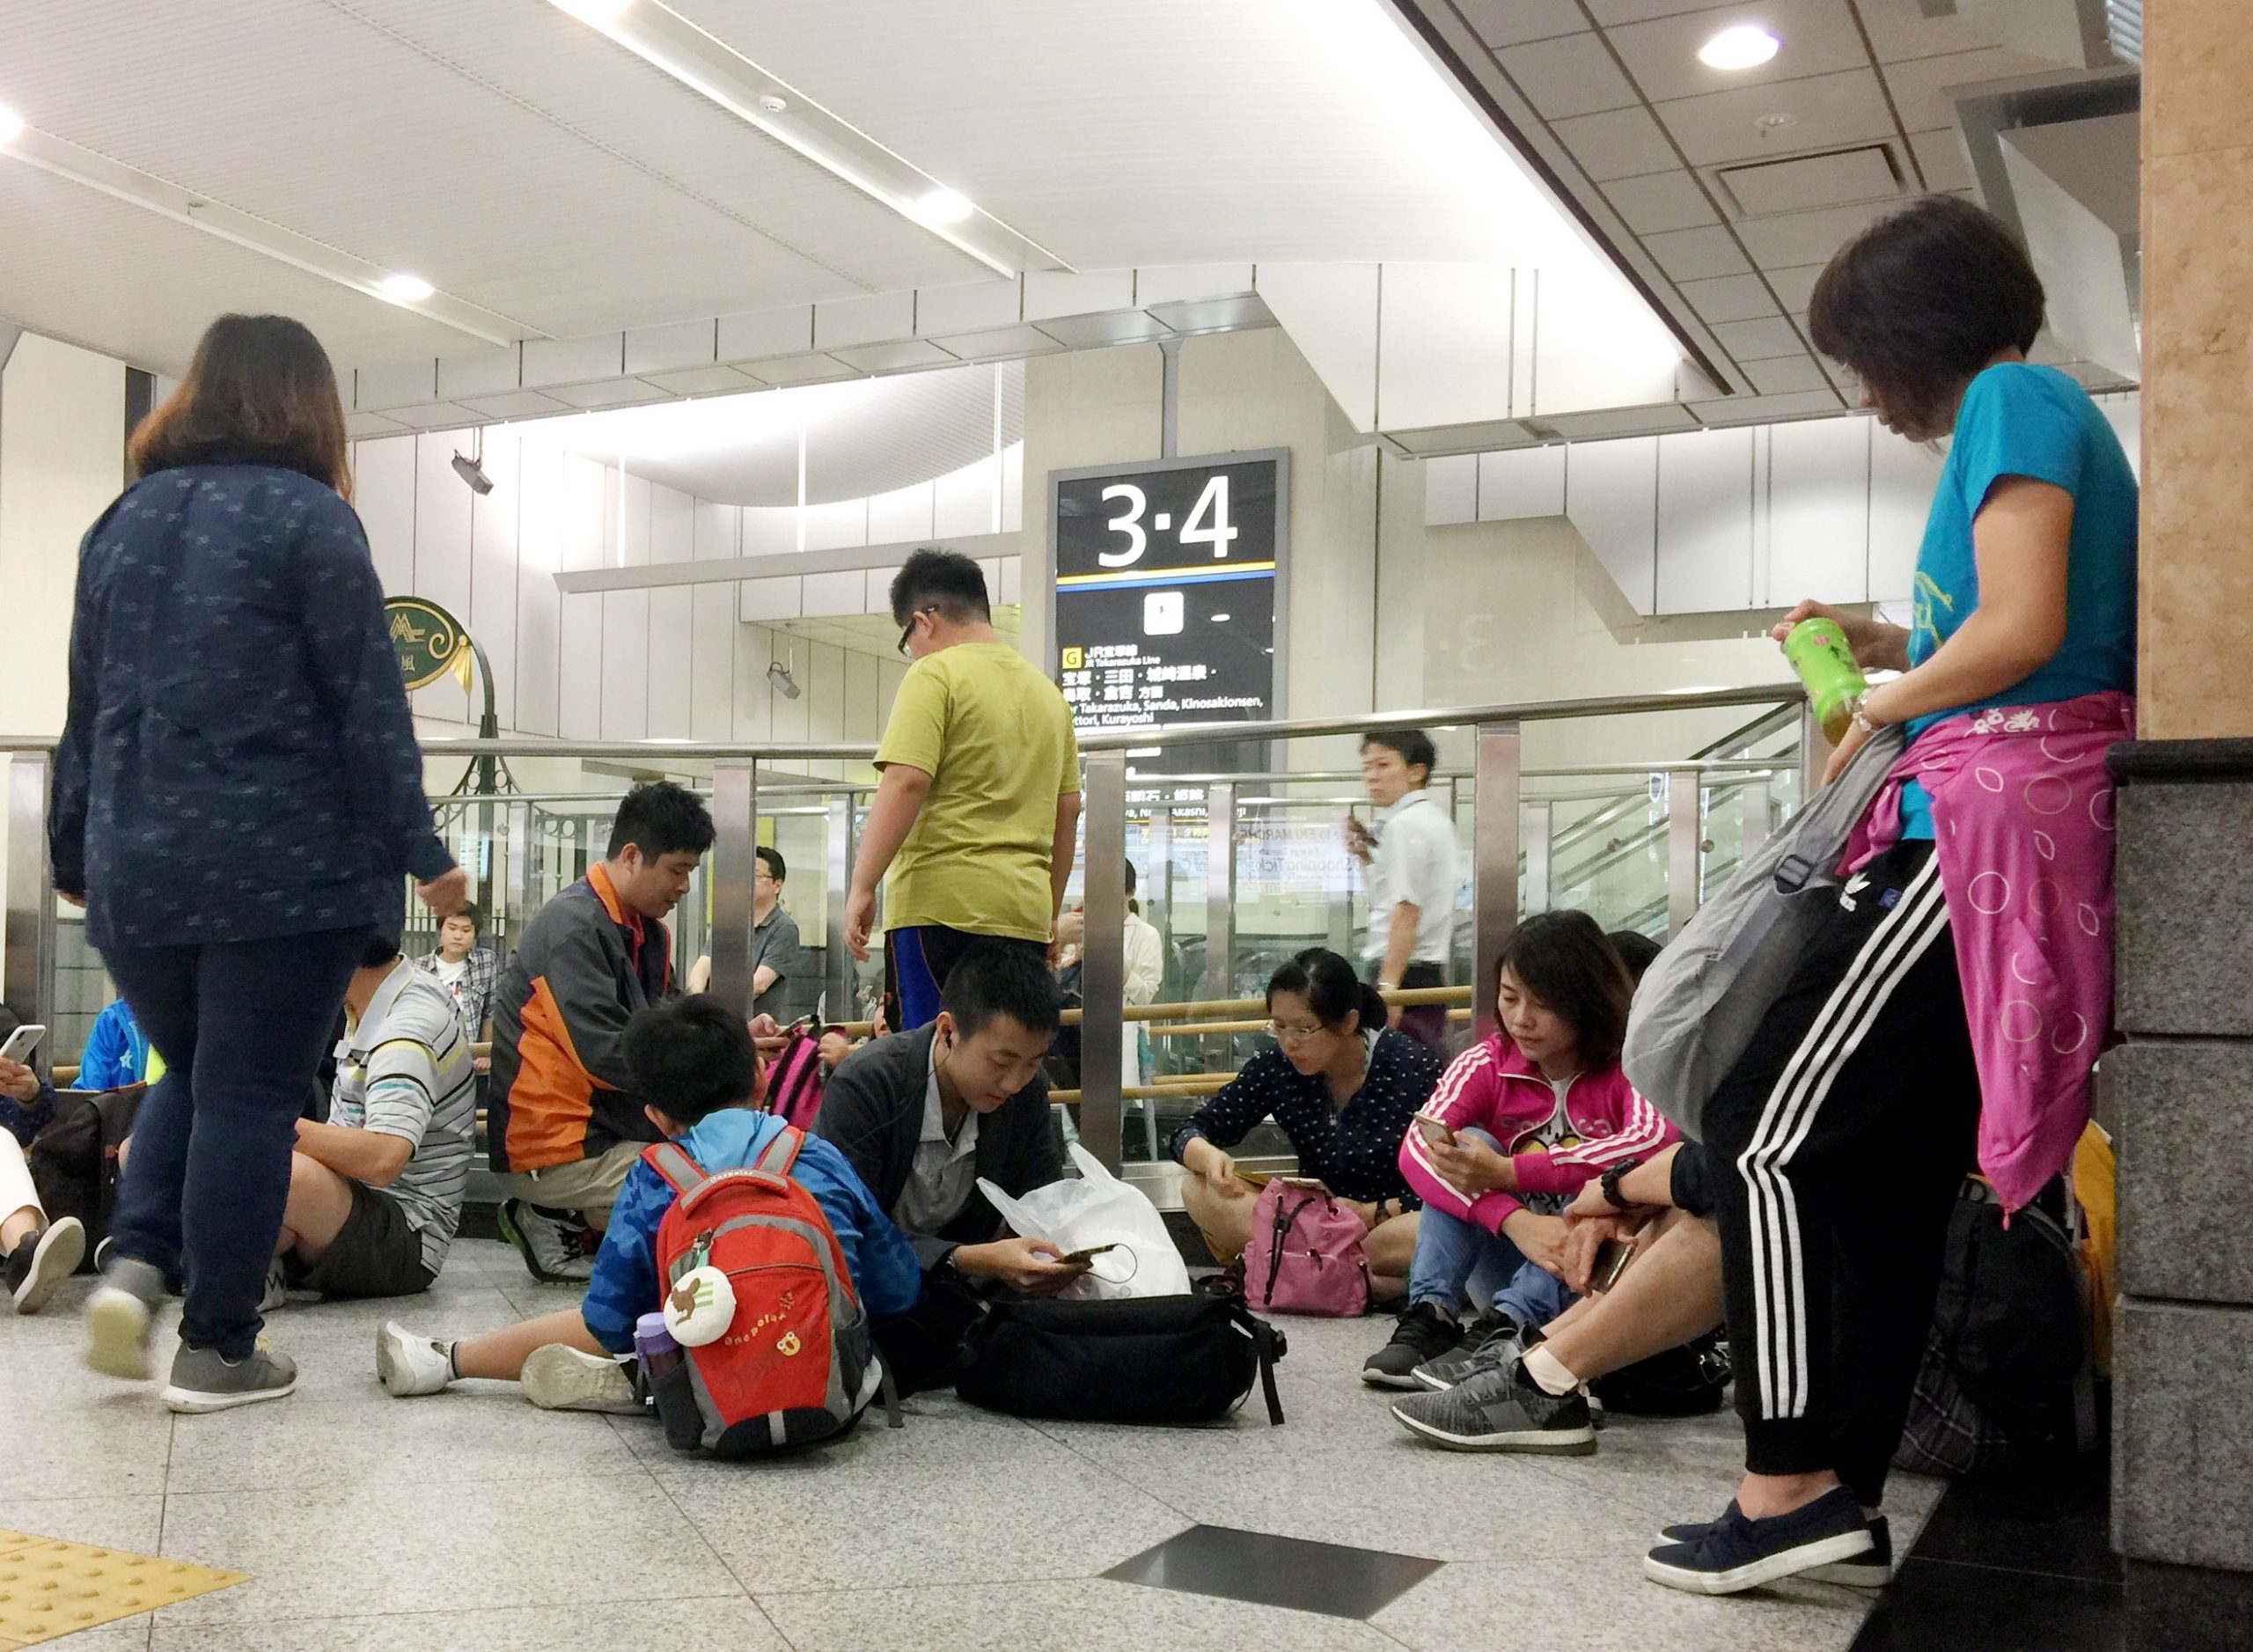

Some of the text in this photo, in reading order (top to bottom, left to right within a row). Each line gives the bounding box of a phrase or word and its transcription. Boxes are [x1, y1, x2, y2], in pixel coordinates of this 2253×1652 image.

[1095, 657, 1141, 667] Takarazuka
[1142, 656, 1161, 664] Line
[1079, 701, 1141, 714] Takarazuka,
[1143, 699, 1179, 712] Sanda,
[1072, 712, 1155, 727] ttori, Kurayoshi
